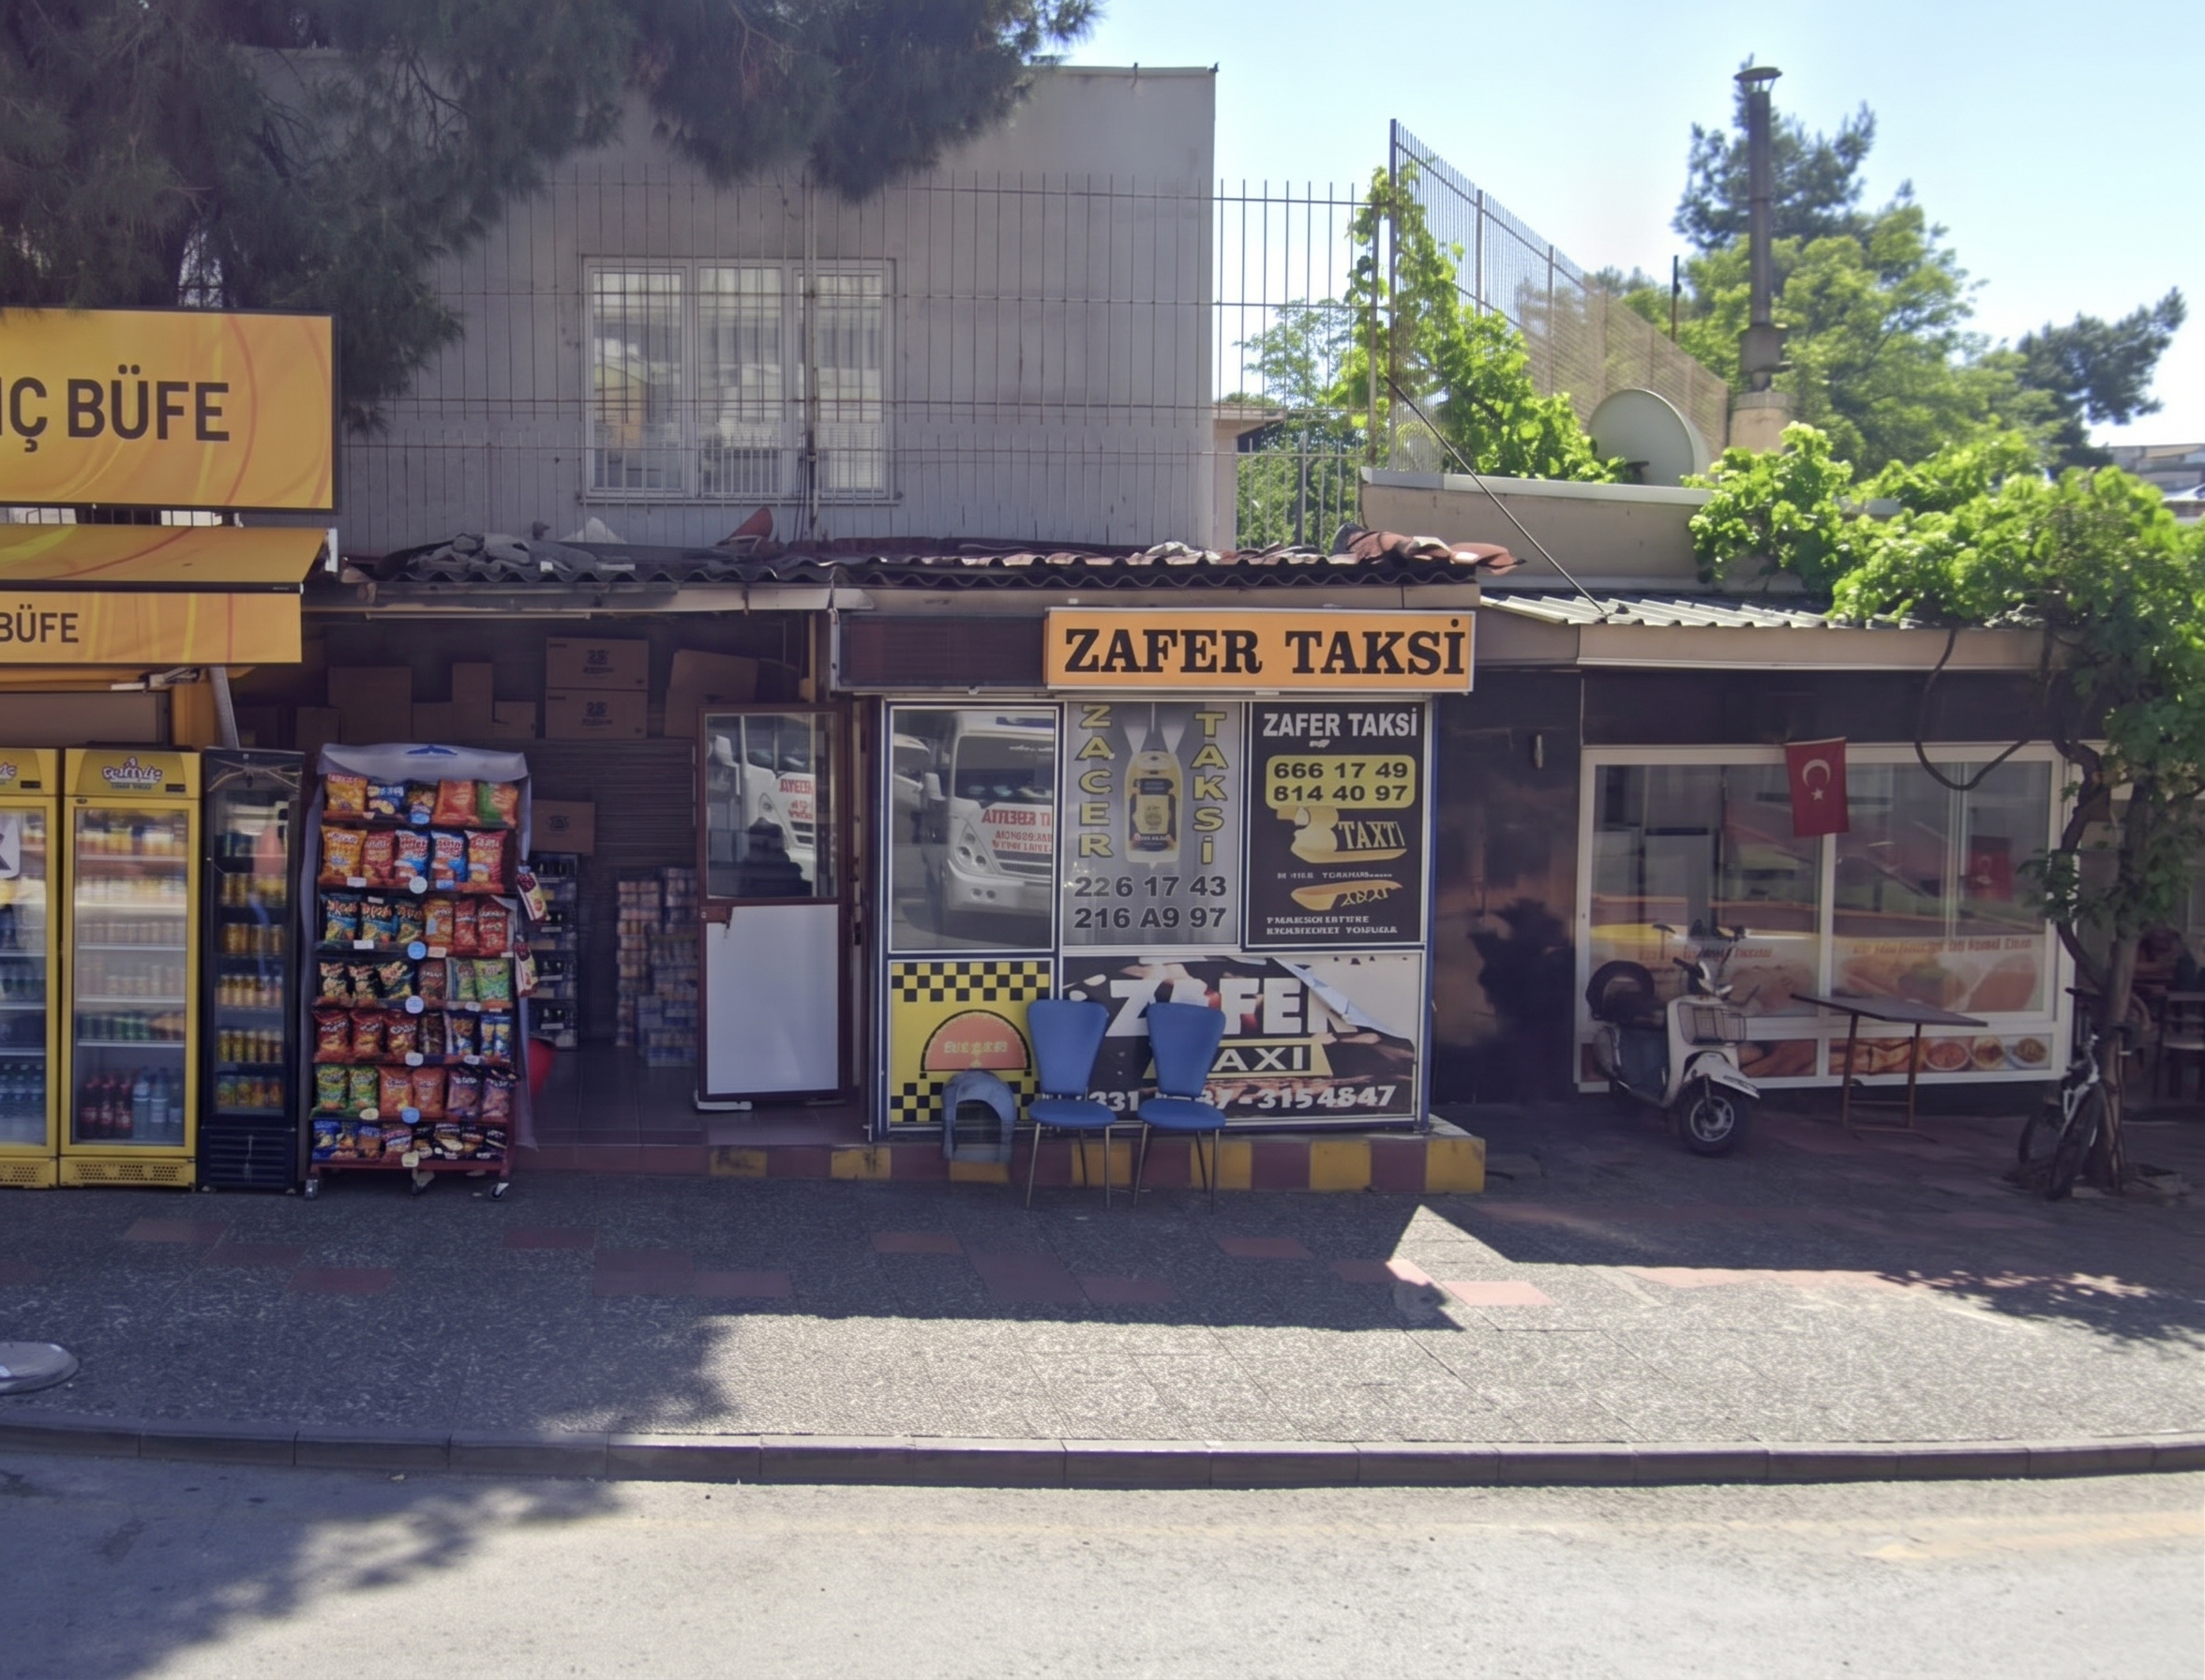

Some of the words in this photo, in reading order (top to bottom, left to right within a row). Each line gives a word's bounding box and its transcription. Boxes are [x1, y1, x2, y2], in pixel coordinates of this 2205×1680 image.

[0, 376, 47, 453] Ç
[68, 364, 230, 442] BÜFE
[0, 604, 79, 643] BÜFE
[1064, 628, 1263, 674] ZAFER
[1285, 619, 1466, 676] TAKSİ
[1263, 712, 1341, 737] ZAFER
[1347, 707, 1418, 737] TAKSİ
[1273, 761, 1324, 779] 666
[1334, 761, 1366, 779] 17
[1374, 761, 1408, 779] 49
[1332, 785, 1365, 802] 40
[1374, 785, 1408, 802] 97
[1073, 876, 1133, 897] 226
[1144, 876, 1179, 897] 17
[1189, 876, 1227, 897] 43
[1073, 907, 1131, 928] 216
[1190, 907, 1227, 928] 97
[1211, 1046, 1304, 1072] AXI
